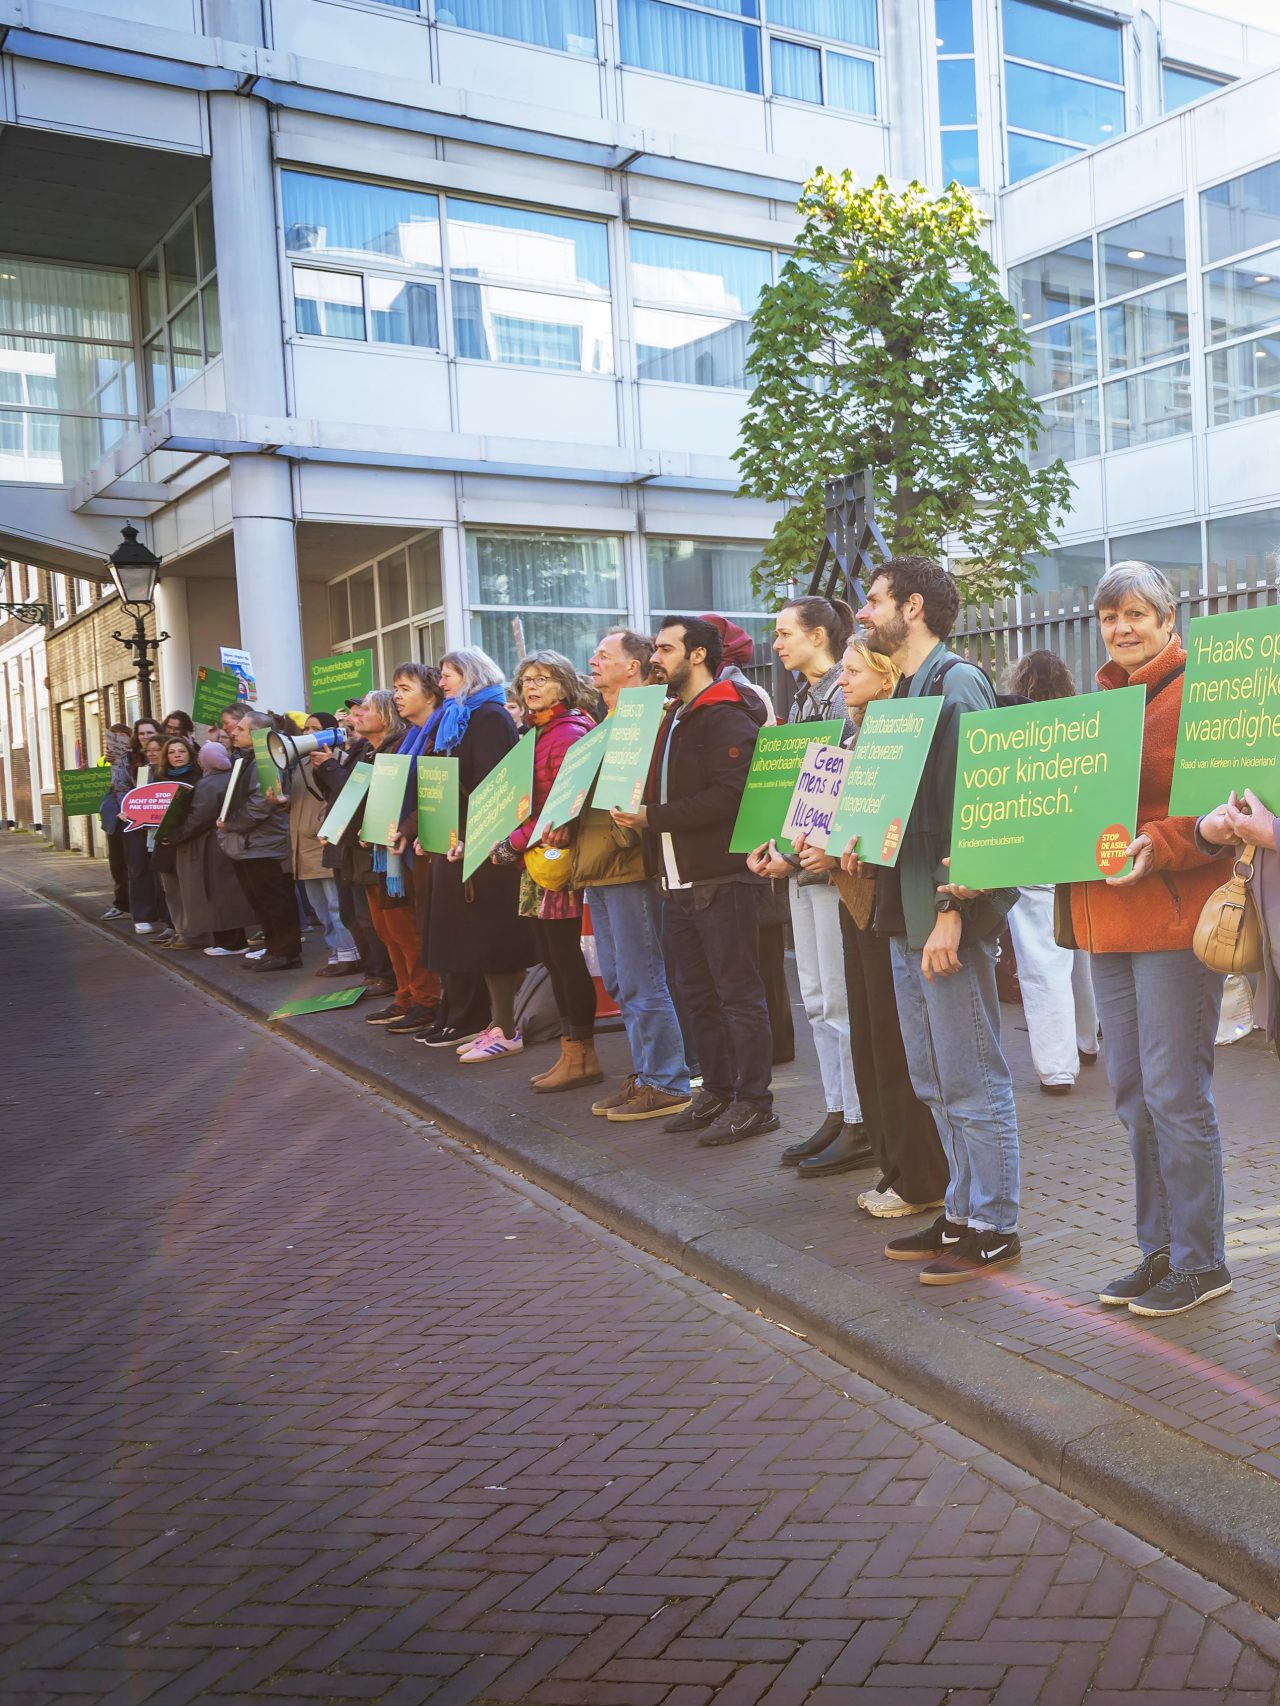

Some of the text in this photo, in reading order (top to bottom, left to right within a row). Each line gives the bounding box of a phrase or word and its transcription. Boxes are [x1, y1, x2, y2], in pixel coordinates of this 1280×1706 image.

[1194, 631, 1255, 665] 'Haaks
[355, 658, 365, 667] en
[965, 711, 1101, 755] 'Onveiligheid
[782, 736, 811, 754] zorgen
[868, 741, 904, 760] bewezen
[814, 747, 844, 775] Geen
[1179, 755, 1277, 769] Raad van Kerken in Nederland
[963, 752, 1108, 789] voor kinderen
[798, 772, 842, 797] mens is
[960, 785, 1079, 831] gigantisch.'
[958, 835, 1025, 848] Kinderombudsman
[1102, 833, 1120, 842] STOP
[1110, 841, 1127, 849] ASIEL
[1098, 859, 1110, 867] .NL
